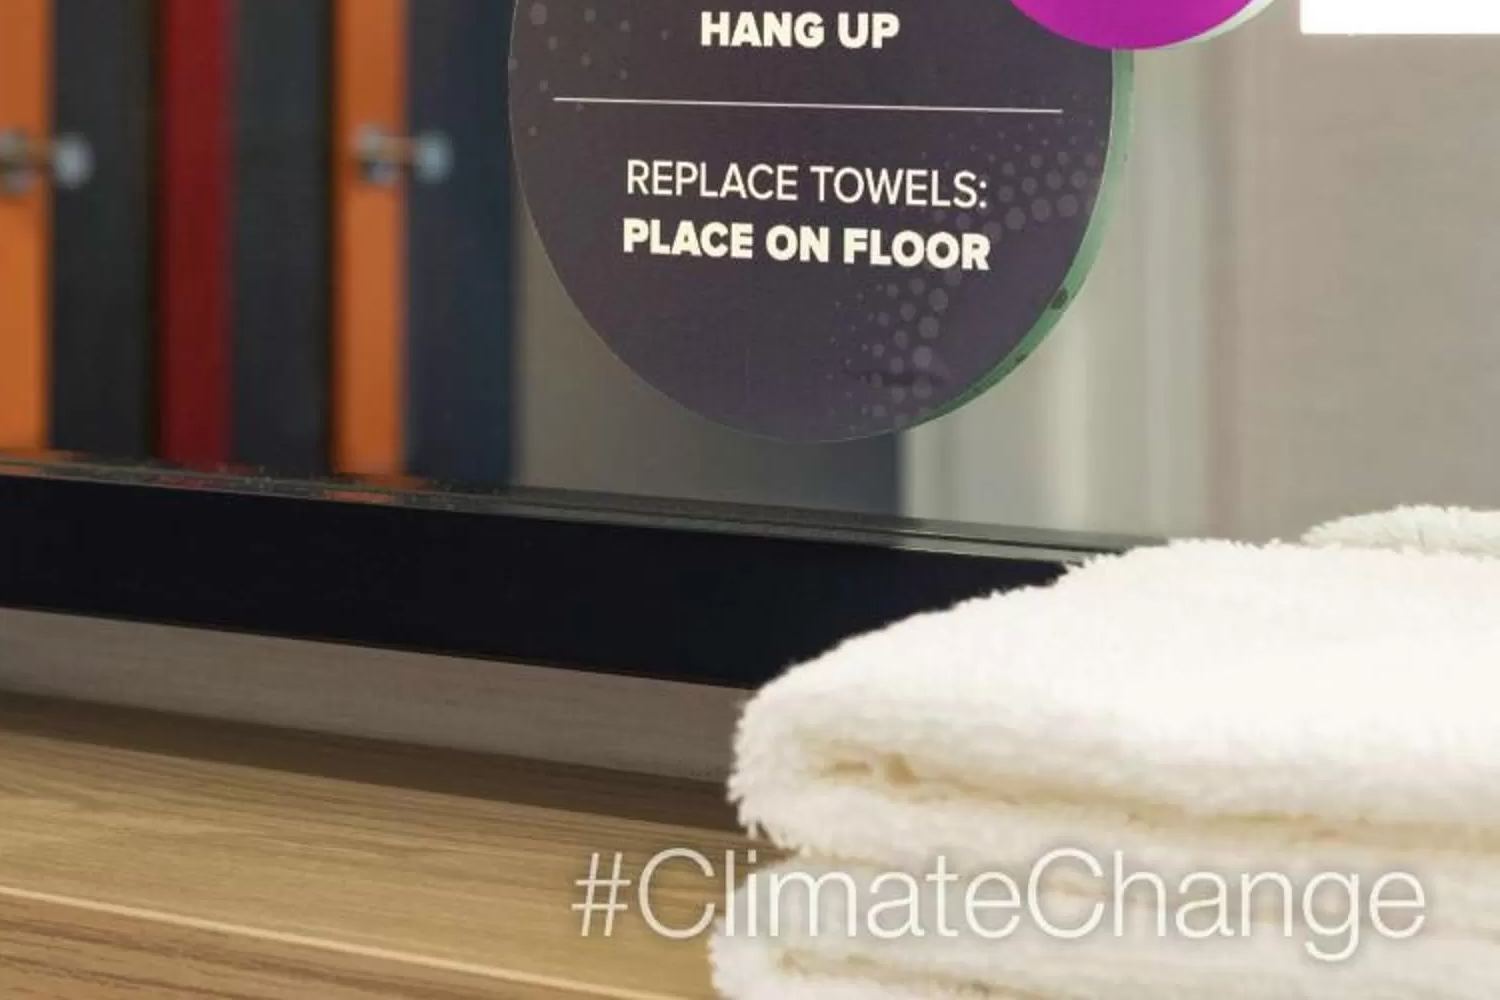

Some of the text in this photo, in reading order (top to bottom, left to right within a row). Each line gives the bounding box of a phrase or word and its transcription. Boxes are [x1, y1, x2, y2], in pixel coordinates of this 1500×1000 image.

[700, 11, 900, 49] HANG UP
[626, 160, 988, 208] REPLACE TOWELS:
[623, 218, 992, 270] PLACE ON FLOOR
